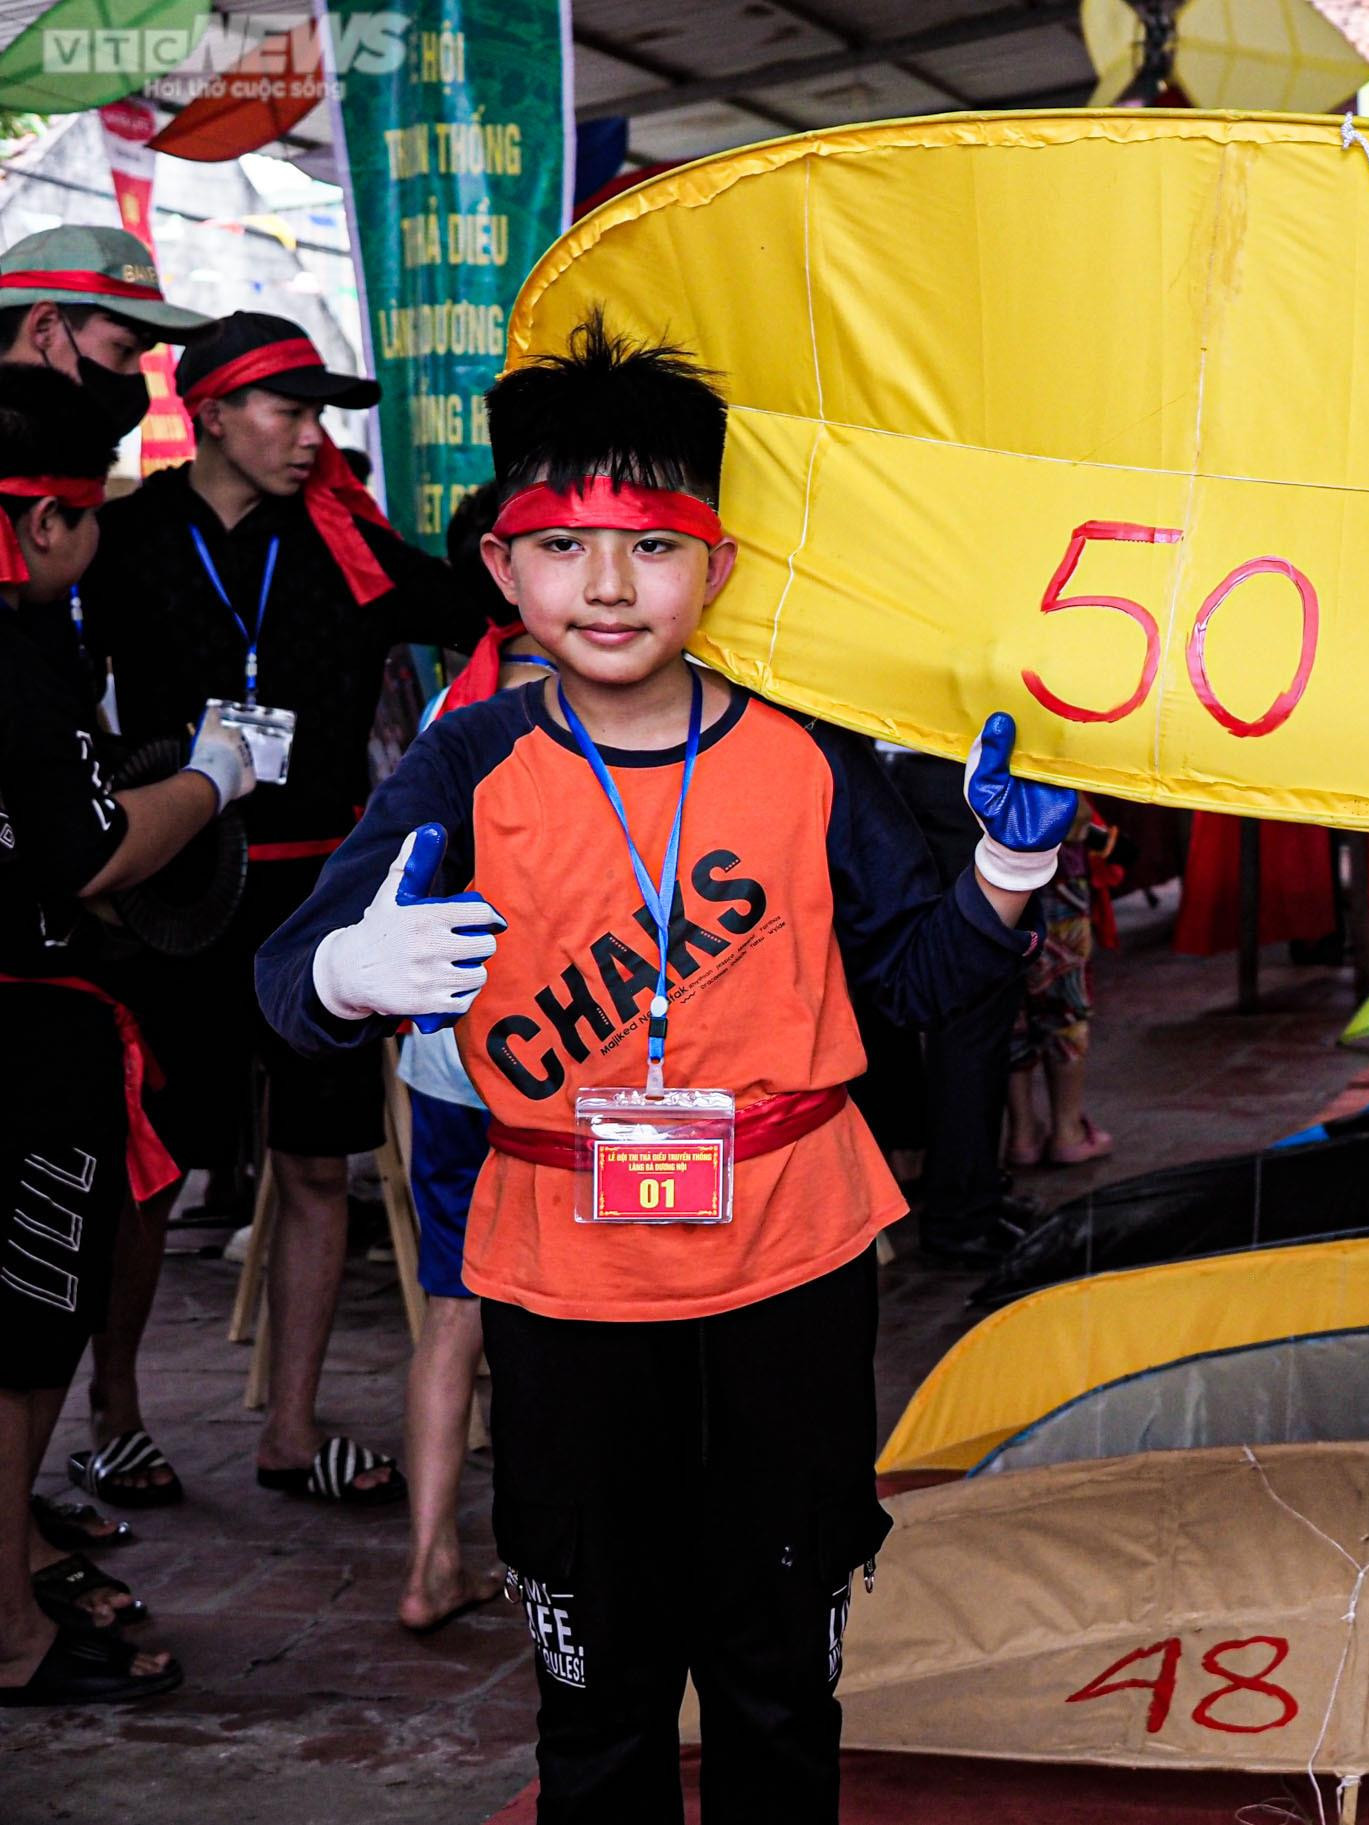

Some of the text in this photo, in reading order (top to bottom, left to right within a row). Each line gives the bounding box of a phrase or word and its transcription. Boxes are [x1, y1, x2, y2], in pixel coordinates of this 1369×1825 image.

[435, 105, 522, 176] THỐNG
[1021, 519, 1319, 738] 50
[486, 849, 767, 1101] CHAKS
[640, 1178, 675, 1209] 01
[1065, 1635, 1299, 1733] 48
